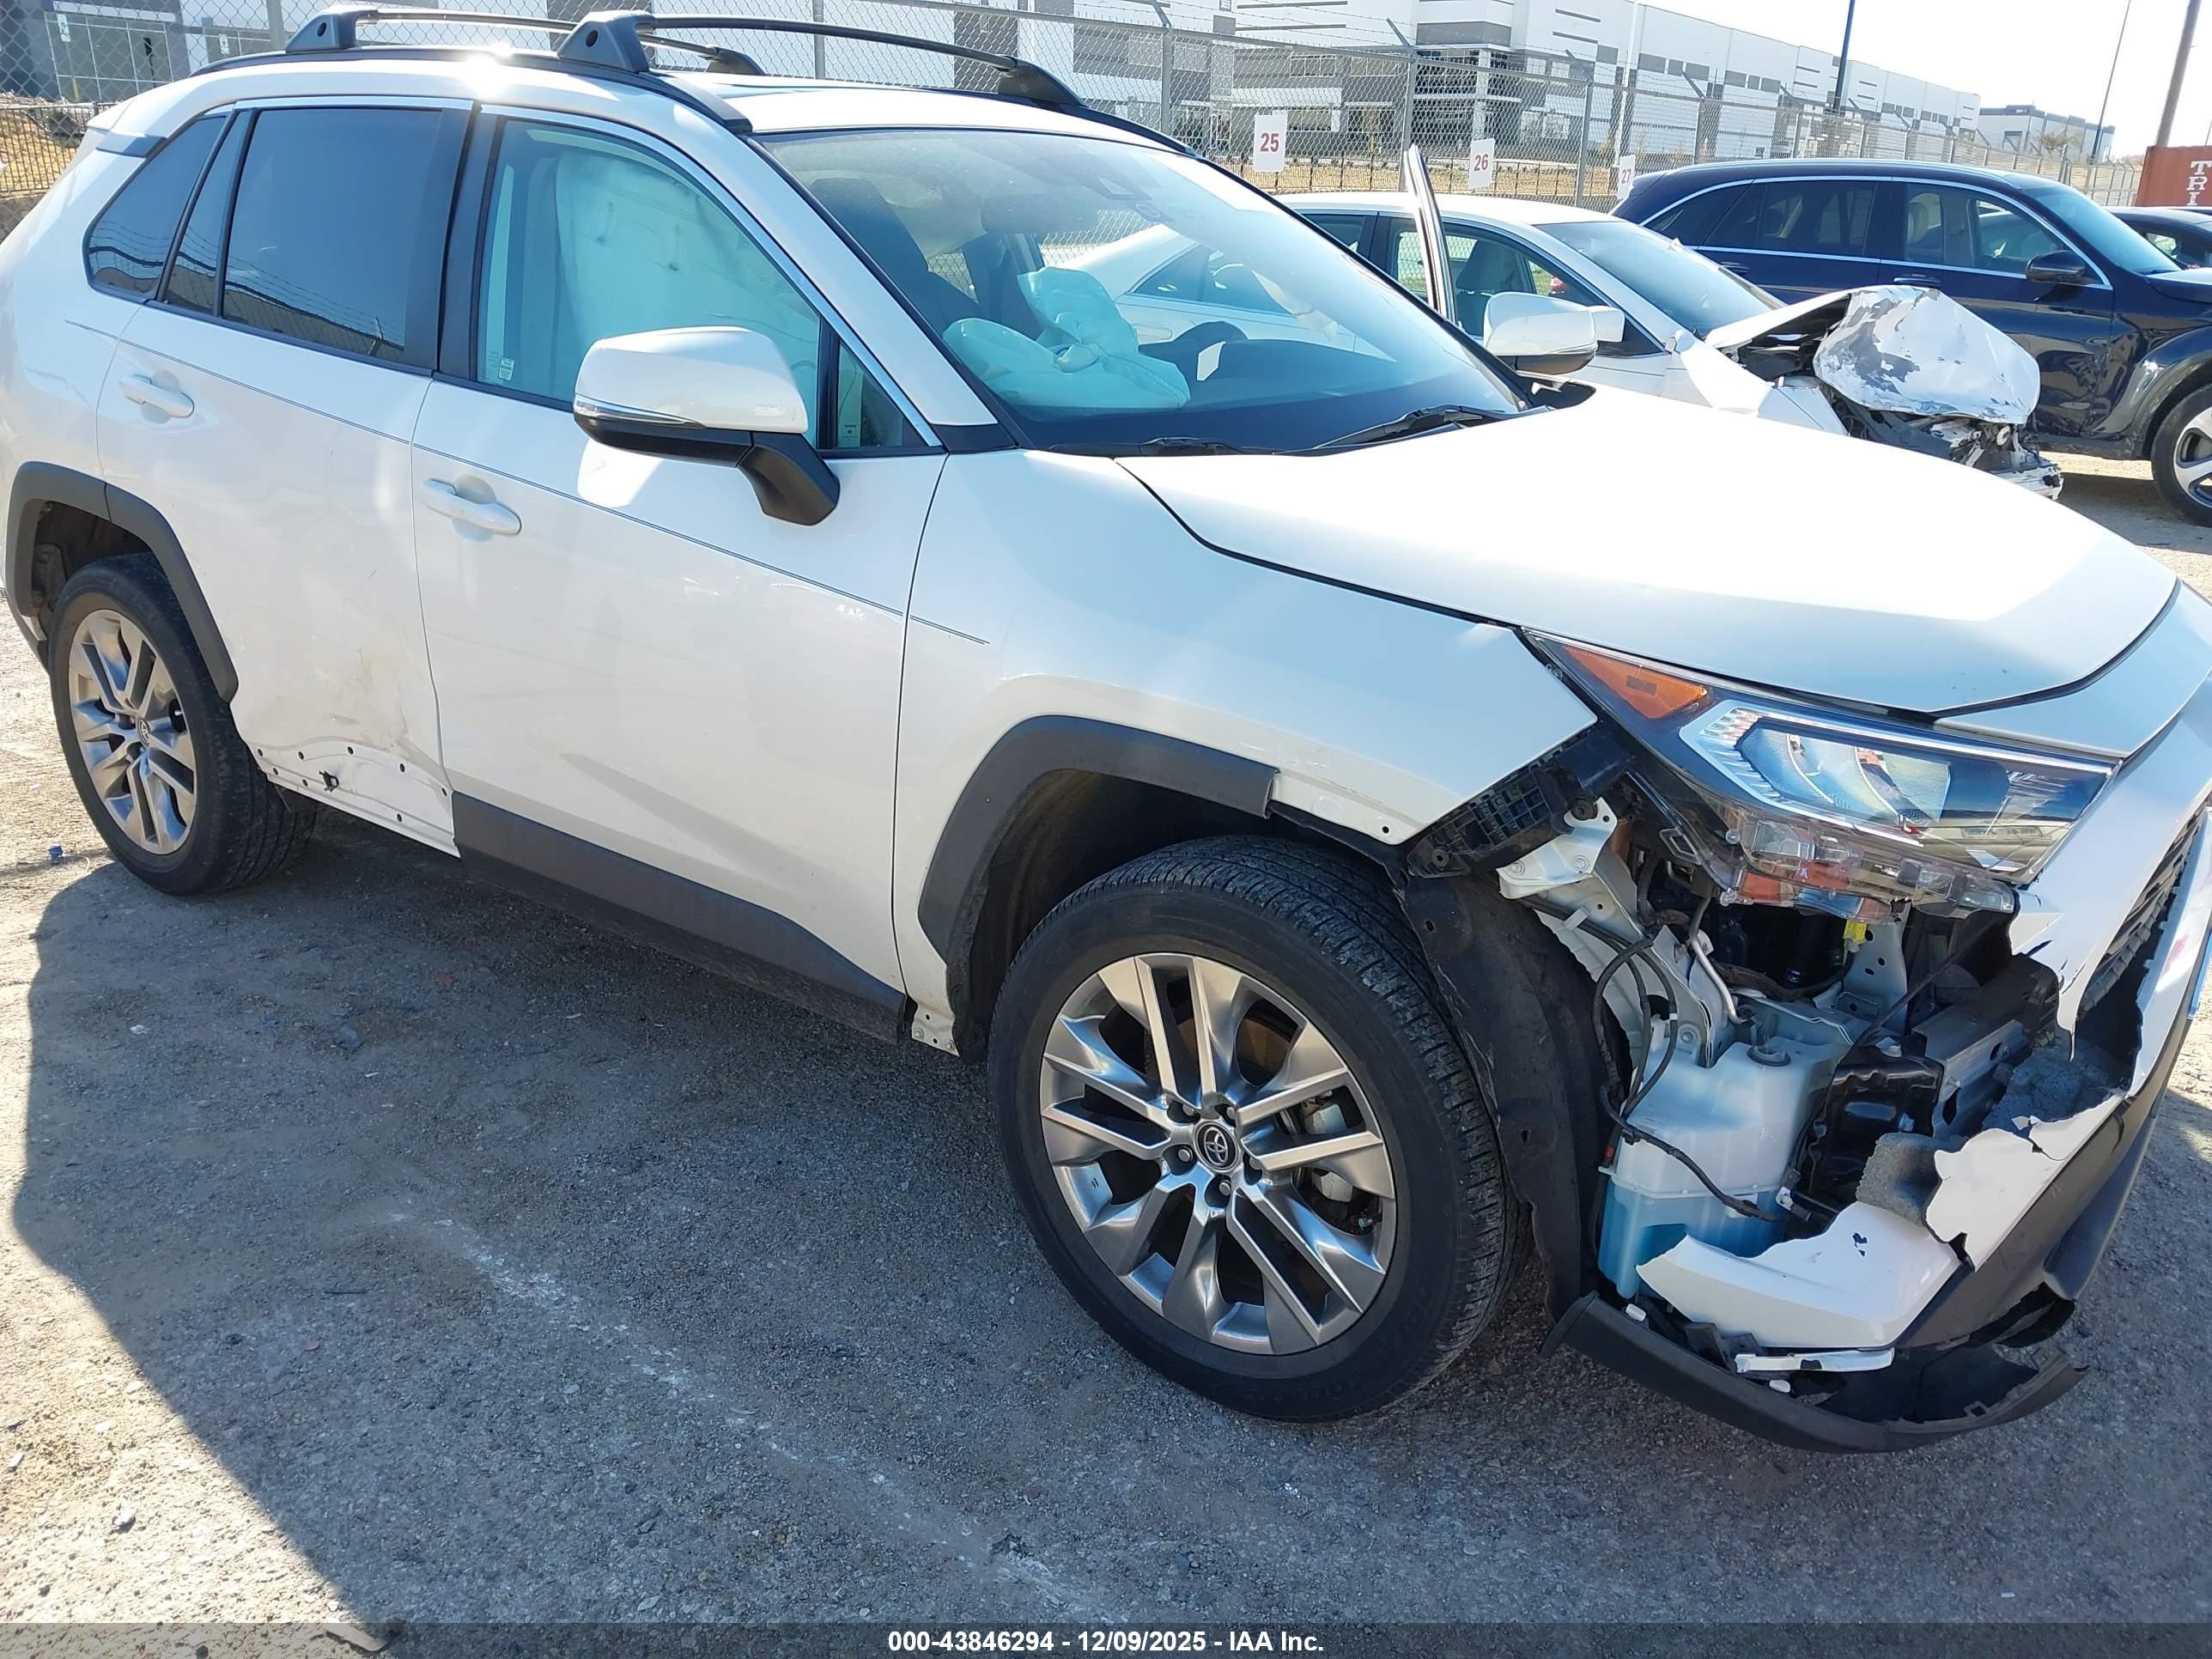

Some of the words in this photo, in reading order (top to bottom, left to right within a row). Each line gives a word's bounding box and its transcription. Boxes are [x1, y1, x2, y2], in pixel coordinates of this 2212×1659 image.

[1260, 132, 1279, 152] 25
[1474, 154, 1489, 172] 26
[1621, 168, 1632, 184] 27
